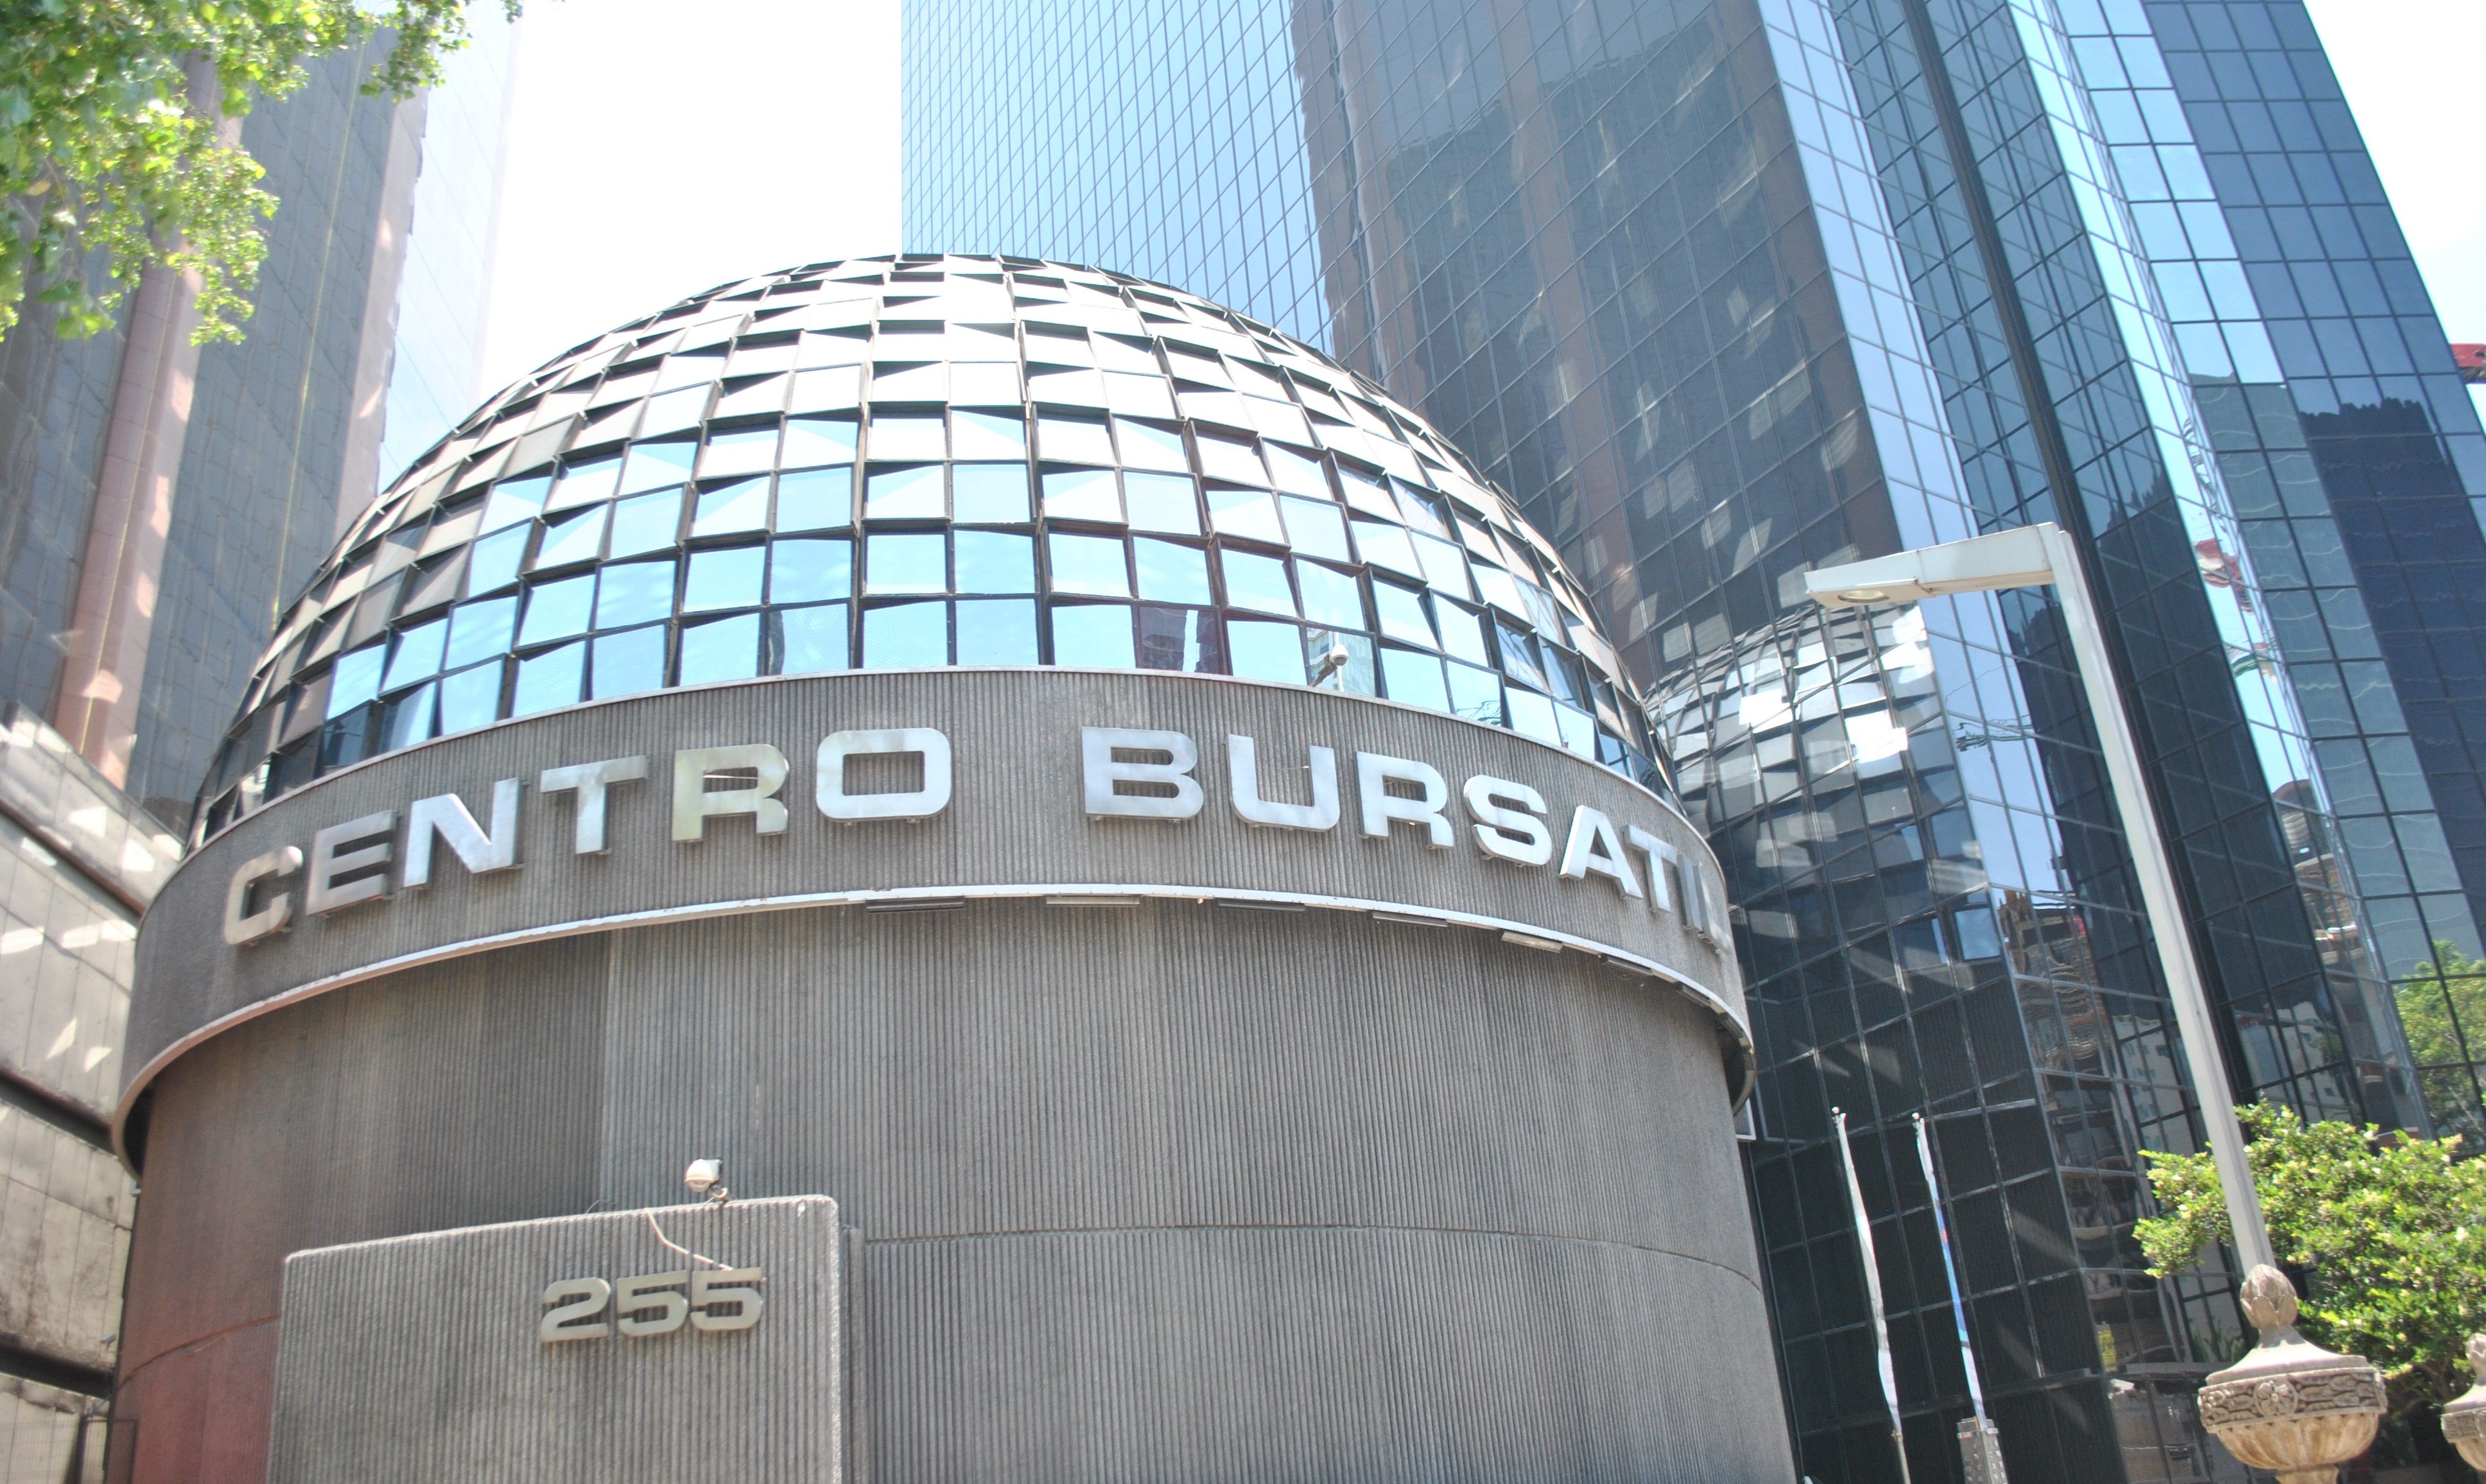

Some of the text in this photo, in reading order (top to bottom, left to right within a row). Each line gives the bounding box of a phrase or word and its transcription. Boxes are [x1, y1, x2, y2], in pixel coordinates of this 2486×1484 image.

[224, 726, 1732, 954] CENTRO BURSATIL
[540, 1267, 763, 1342] 255
